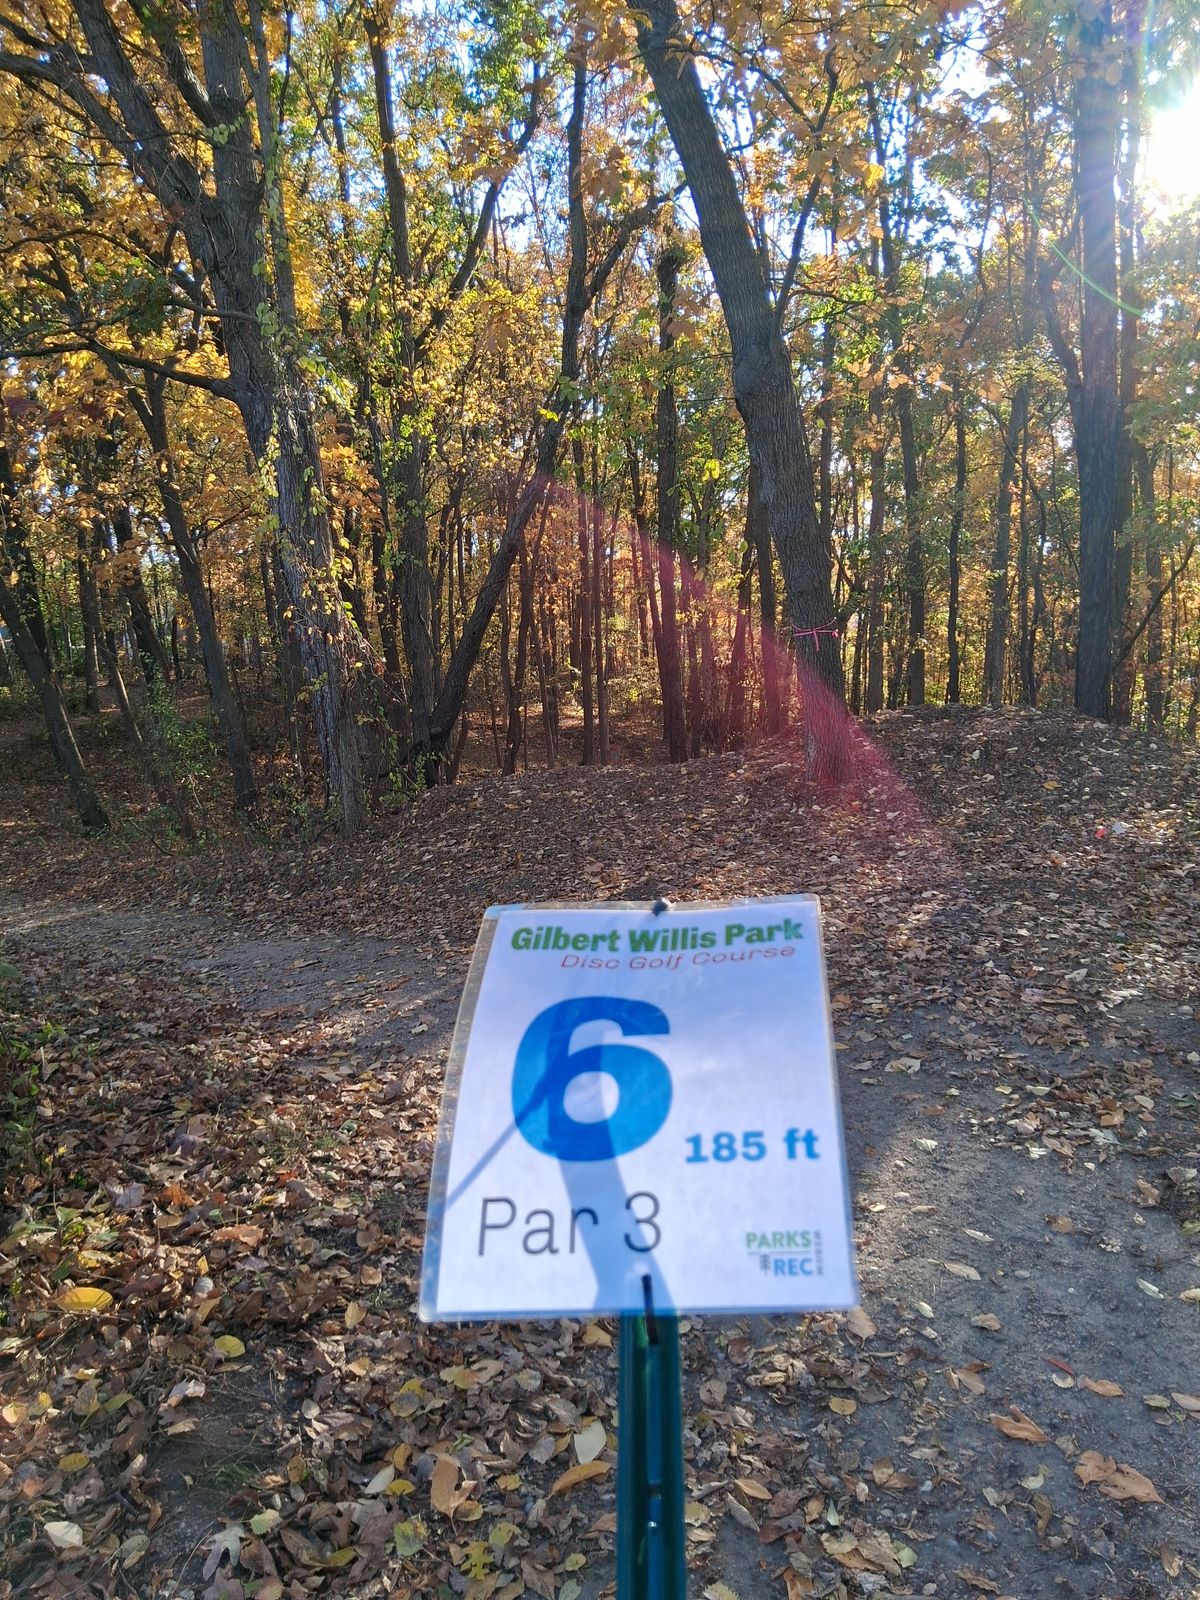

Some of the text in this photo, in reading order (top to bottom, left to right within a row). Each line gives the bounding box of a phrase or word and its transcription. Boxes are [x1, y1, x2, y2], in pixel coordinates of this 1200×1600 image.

[511, 917, 804, 952] Gilbert Willis Park
[560, 945, 796, 970] Disc Golf Course
[511, 996, 672, 1162] 6
[685, 1127, 820, 1163] 185 ft
[477, 1190, 661, 1256] Par 3
[745, 1230, 812, 1248] PARKS
[773, 1258, 813, 1276] REC
